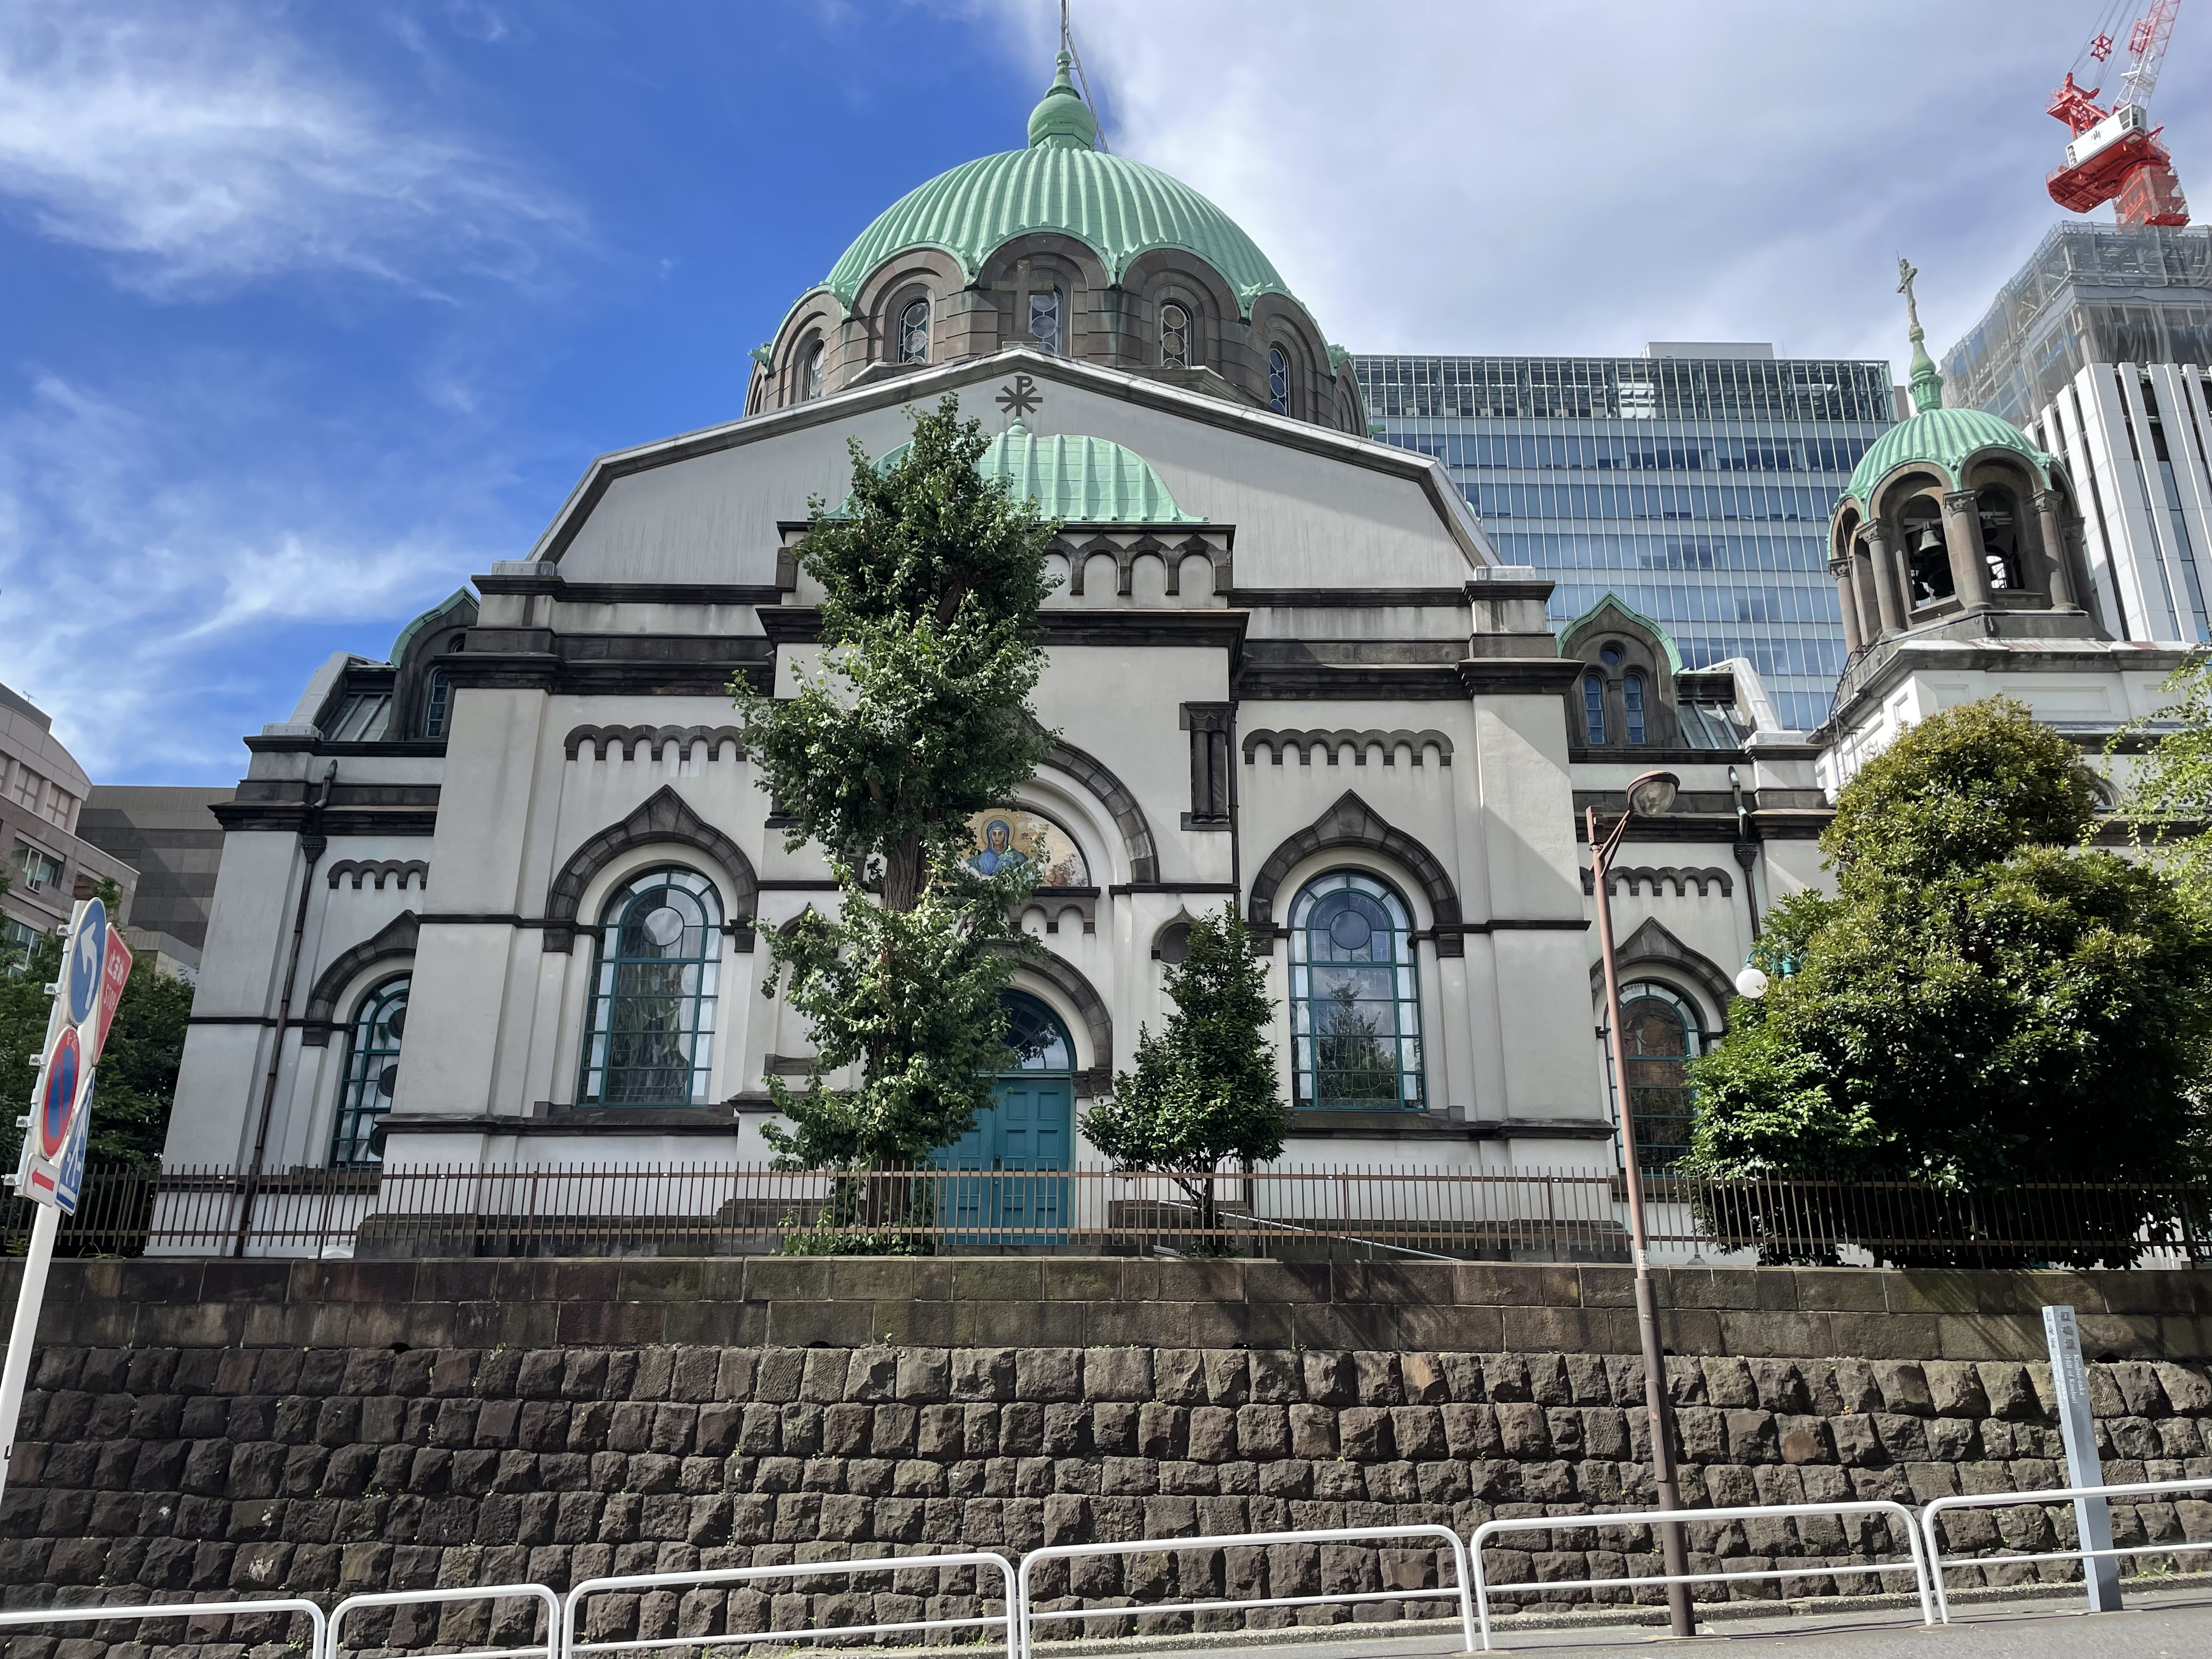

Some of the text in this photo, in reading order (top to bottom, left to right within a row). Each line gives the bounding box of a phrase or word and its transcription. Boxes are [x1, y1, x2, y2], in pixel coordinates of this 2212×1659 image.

[107, 948, 124, 986] 止まれ
[103, 983, 116, 1013] STOP
[2067, 1369, 2075, 1378] of
[2073, 1353, 2086, 1396] Koubai-zaka
[2068, 1378, 2079, 1404] Koubai)
